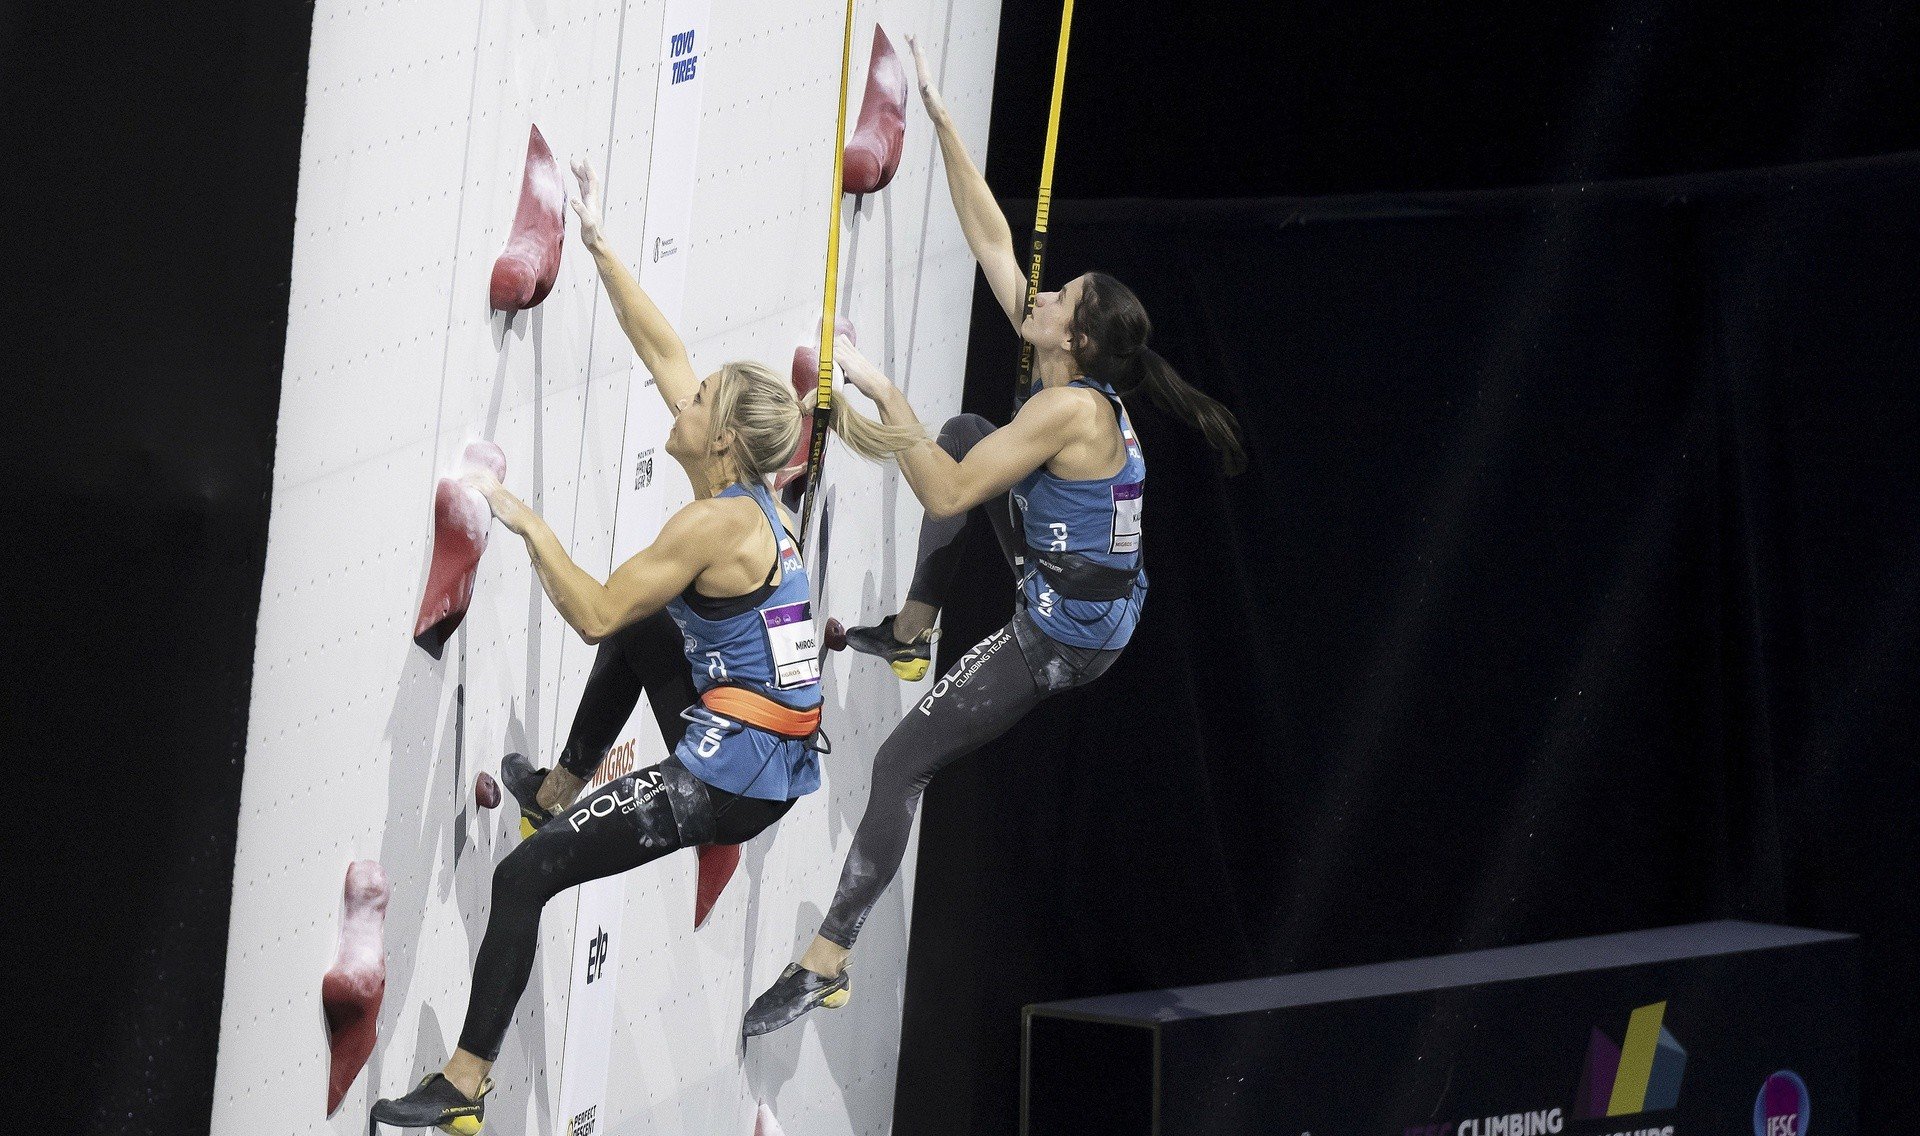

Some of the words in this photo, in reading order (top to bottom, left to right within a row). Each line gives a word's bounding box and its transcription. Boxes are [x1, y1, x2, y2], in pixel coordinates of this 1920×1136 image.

[670, 30, 695, 58] TOYO
[672, 56, 697, 85] TIRES
[783, 559, 803, 574] POL
[955, 653, 991, 688] CLIMBING
[987, 633, 1012, 659] TEAM
[591, 738, 636, 789] MIGROS
[621, 782, 666, 815] CLIMBING
[573, 1104, 597, 1128] PERFECT
[1457, 1107, 1564, 1136] CLIMBING
